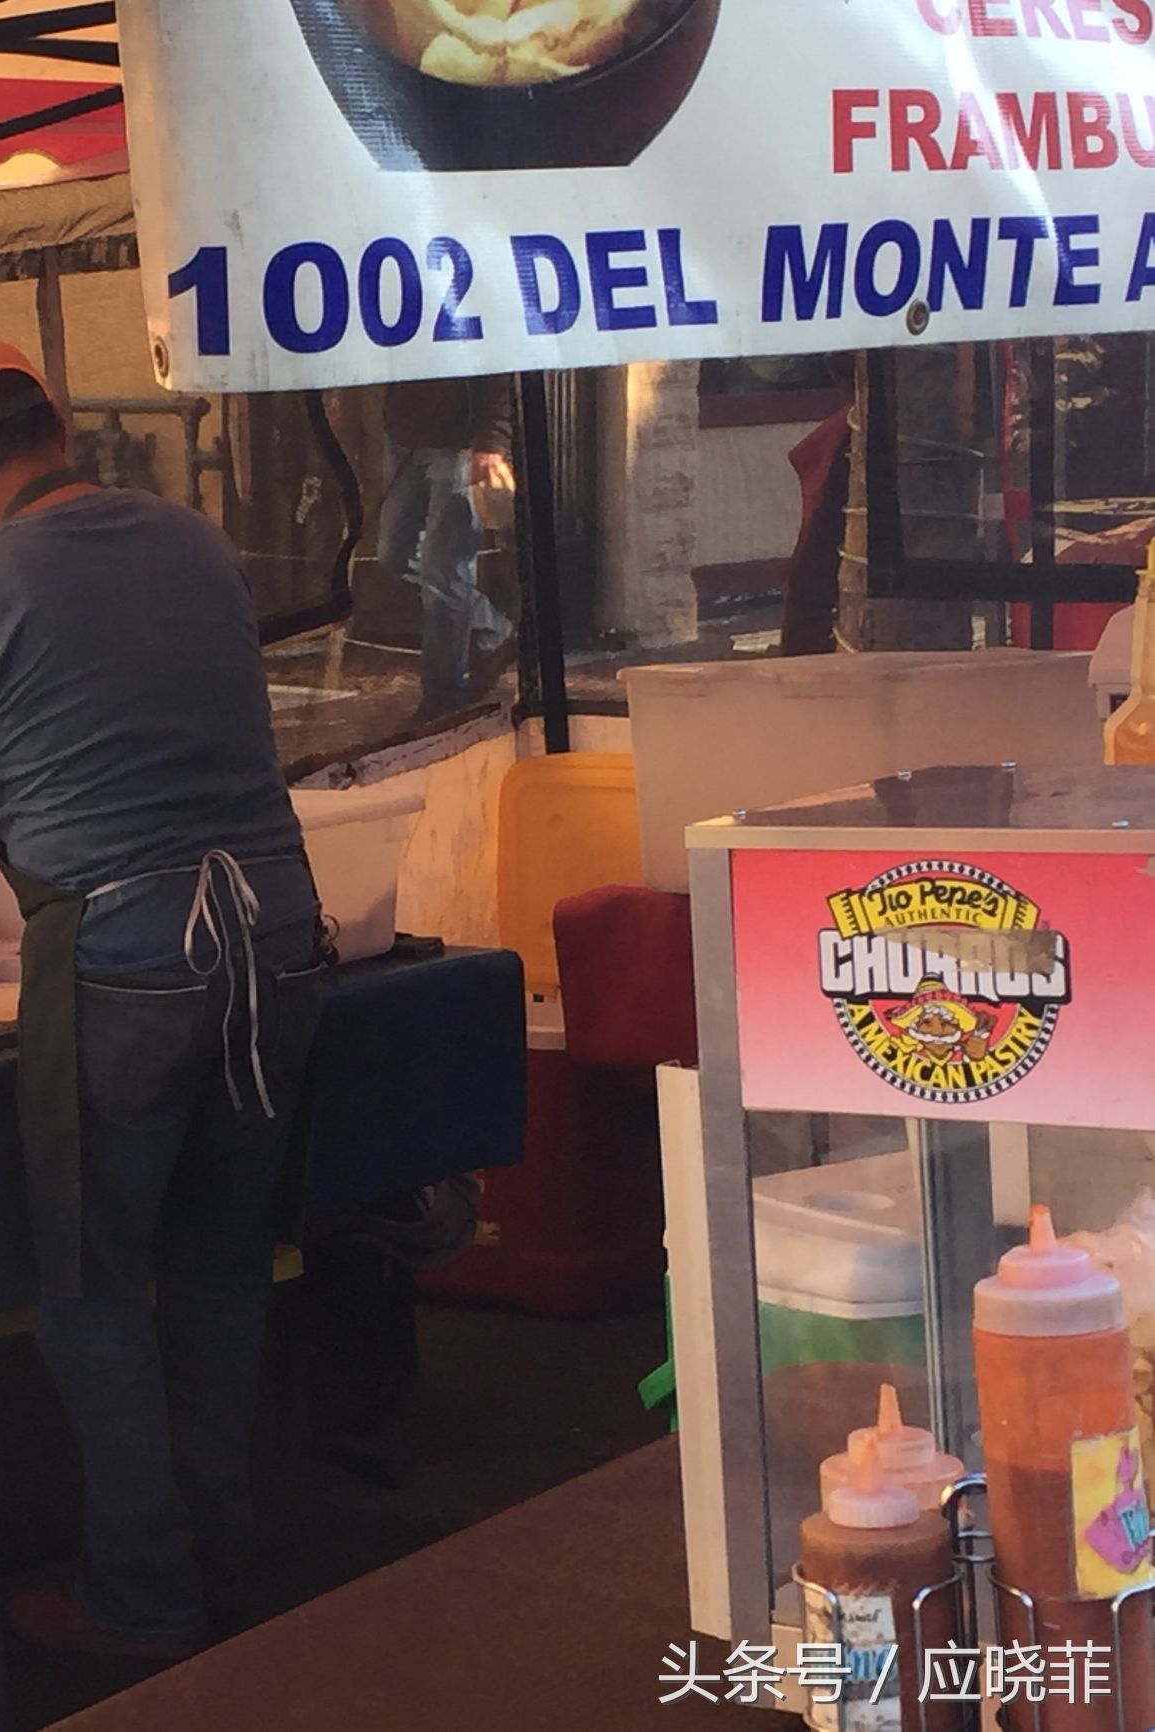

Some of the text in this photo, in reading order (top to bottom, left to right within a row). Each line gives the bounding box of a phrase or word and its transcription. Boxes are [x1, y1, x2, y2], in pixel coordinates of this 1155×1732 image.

[830, 87, 1155, 174] FRAMBU
[168, 234, 484, 358] 1002
[509, 227, 720, 337] DEL
[761, 212, 1102, 323] MONTE
[884, 907, 983, 928] AUTHENTIC
[915, 877, 1000, 918] Pepe's
[858, 1020, 967, 1089] MEXICAN
[968, 1004, 1044, 1086] PASTRY
